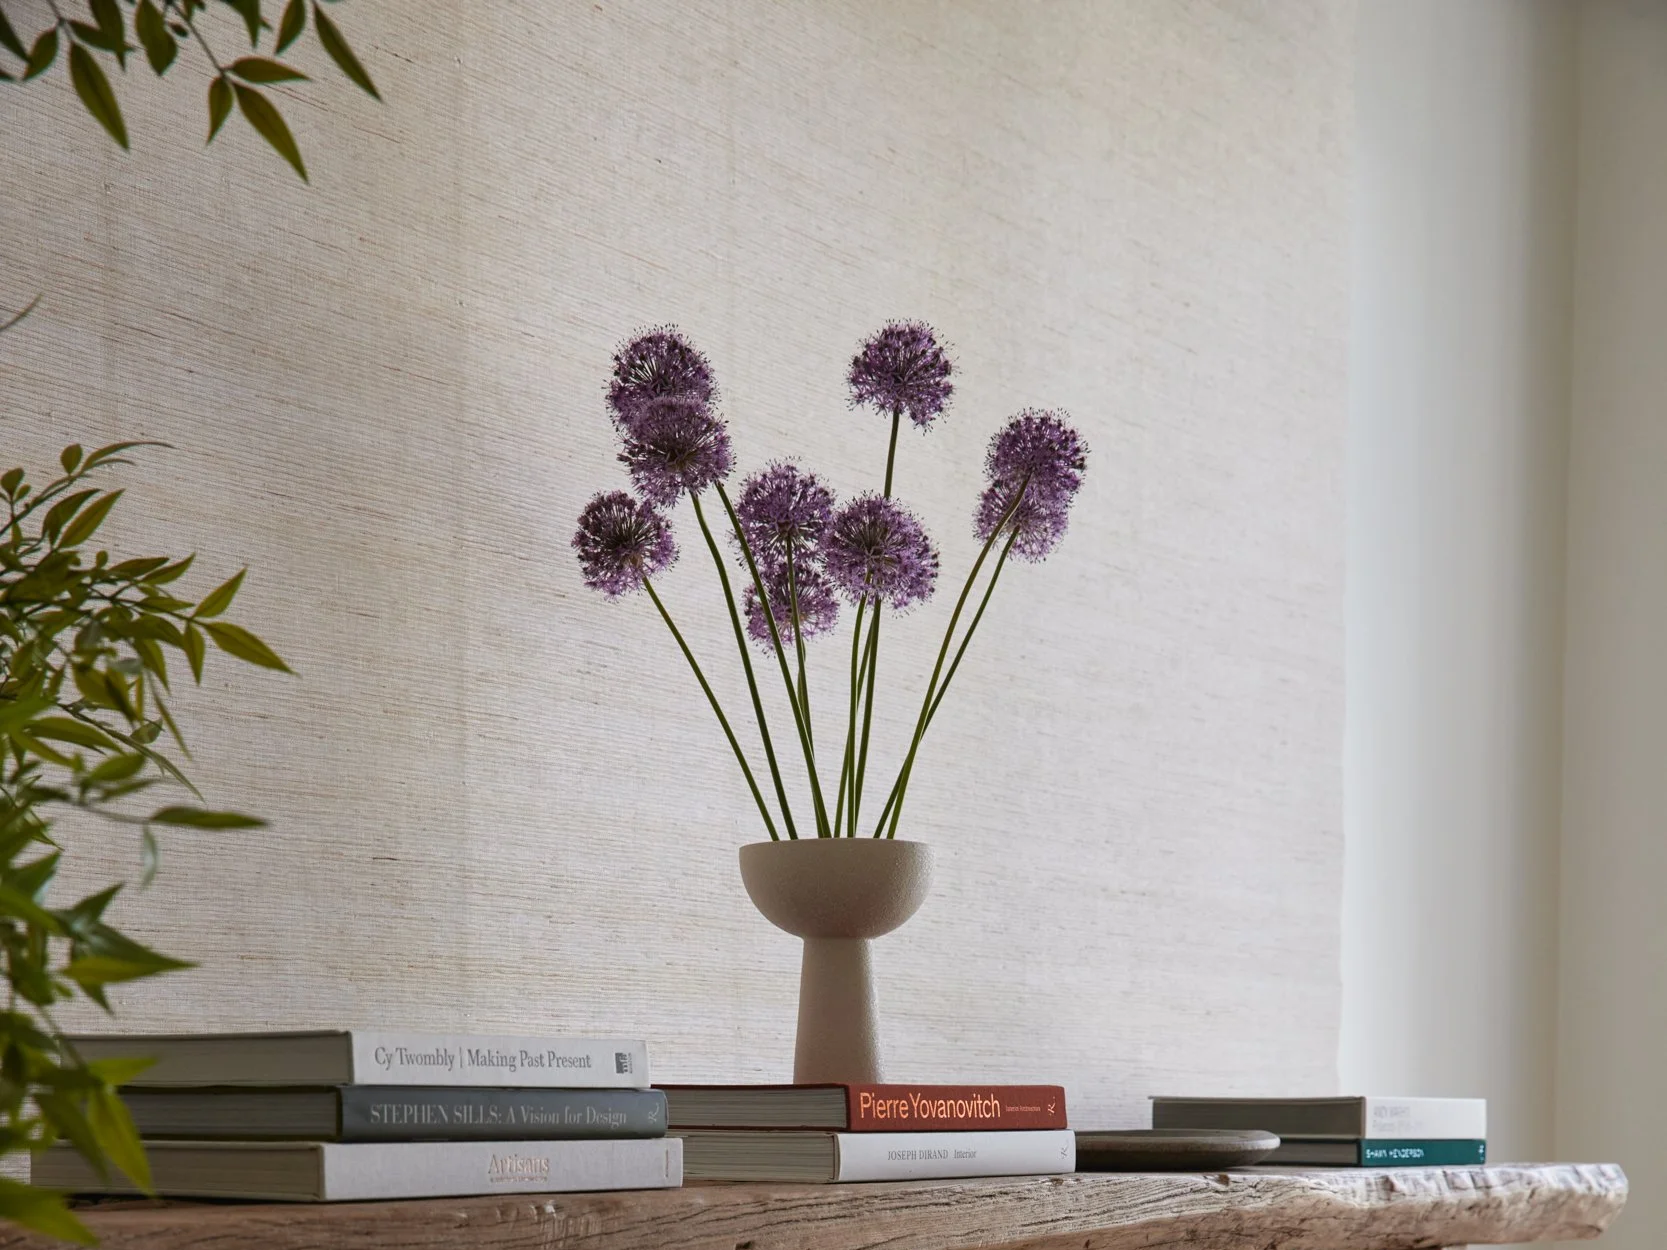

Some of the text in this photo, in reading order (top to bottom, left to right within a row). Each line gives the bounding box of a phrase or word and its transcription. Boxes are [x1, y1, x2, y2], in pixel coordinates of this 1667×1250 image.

[374, 1046, 393, 1071] Cy
[395, 1047, 455, 1072] Twombly
[467, 1048, 517, 1073] Making
[519, 1050, 545, 1068] Past
[547, 1050, 592, 1069] Present
[370, 1103, 627, 1129] STEPHEN SILLS: A Vision for Design
[860, 1092, 1001, 1119] Pierre Yovanovitch
[488, 1153, 550, 1174] Artisans
[888, 1150, 917, 1161] JOSEPH
[919, 1149, 949, 1160] DIRAND
